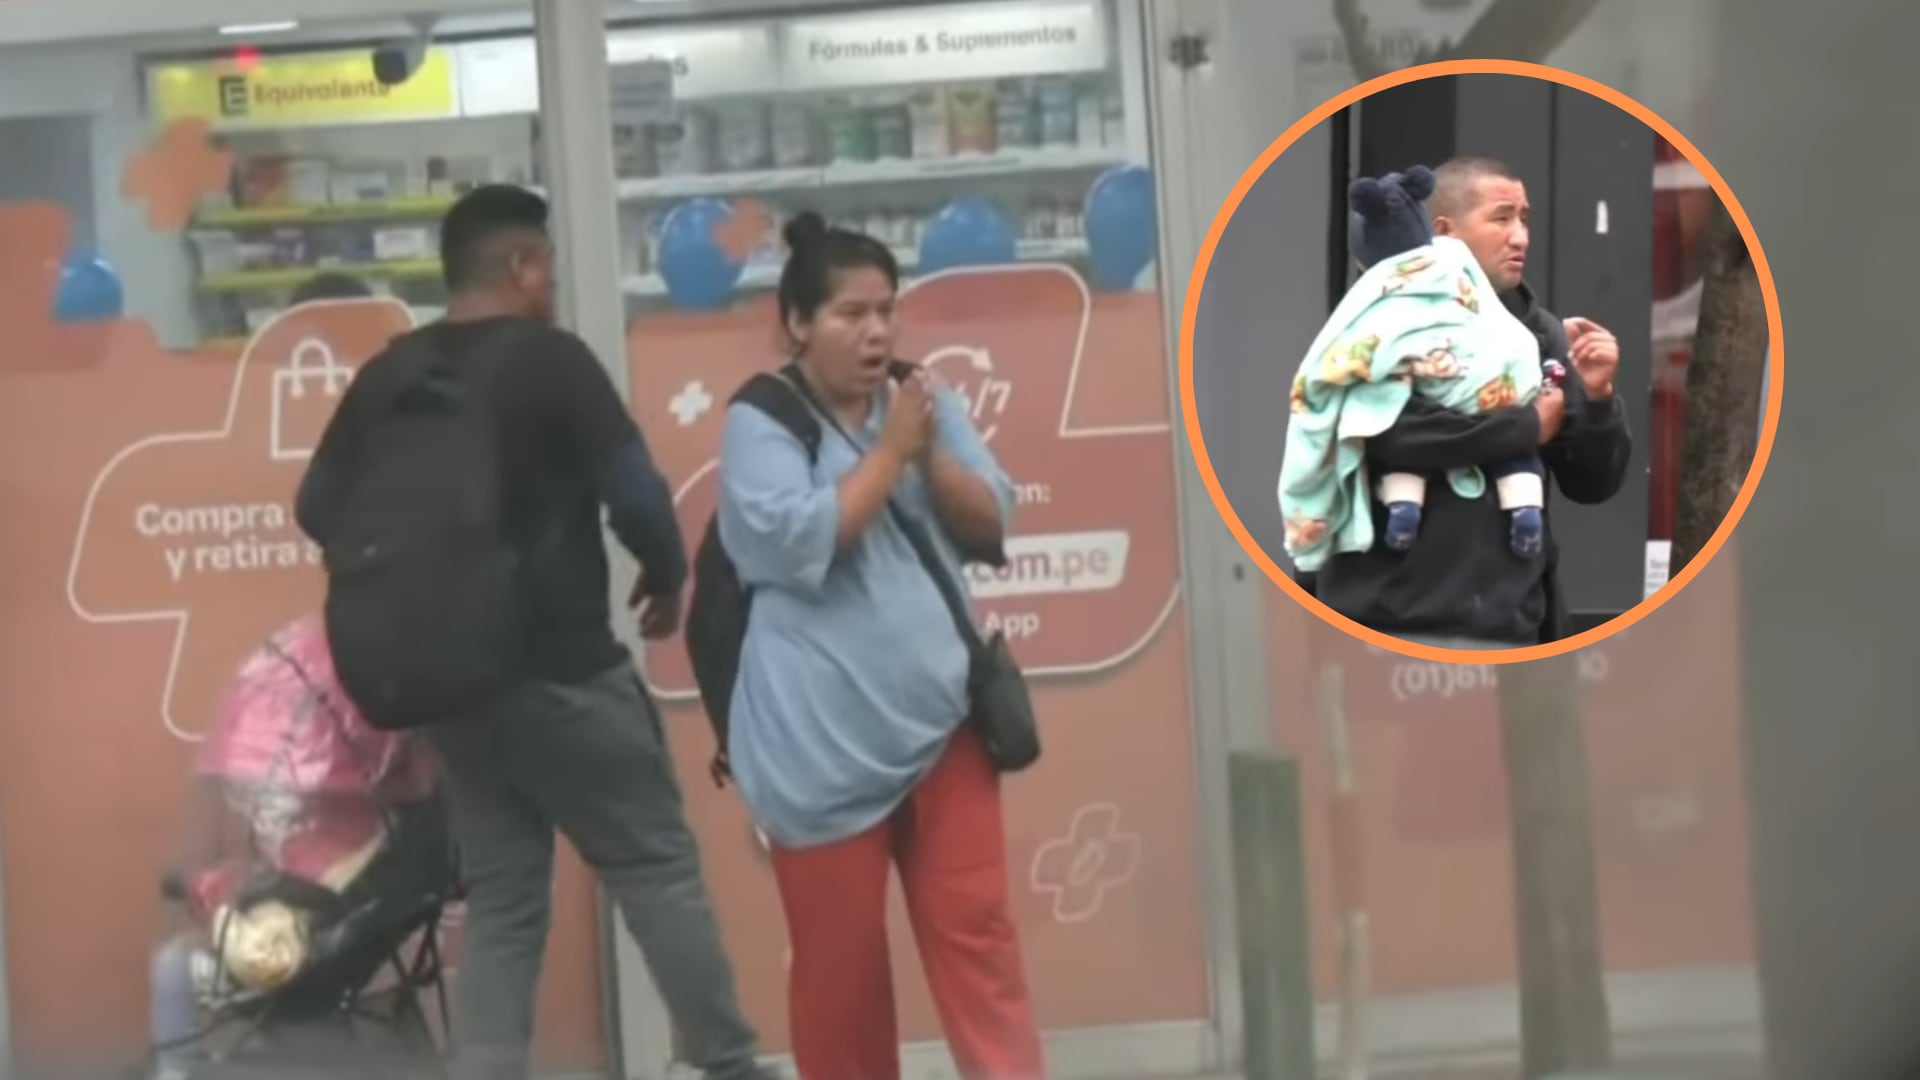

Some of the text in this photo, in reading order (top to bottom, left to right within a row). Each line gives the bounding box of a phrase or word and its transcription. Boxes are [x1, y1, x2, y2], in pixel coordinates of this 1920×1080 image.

[809, 25, 1077, 60] Fórmulas & Suplementos
[135, 501, 284, 537] Compra
[165, 548, 187, 581] y
[195, 534, 298, 571] retira
[985, 609, 1041, 640] App
